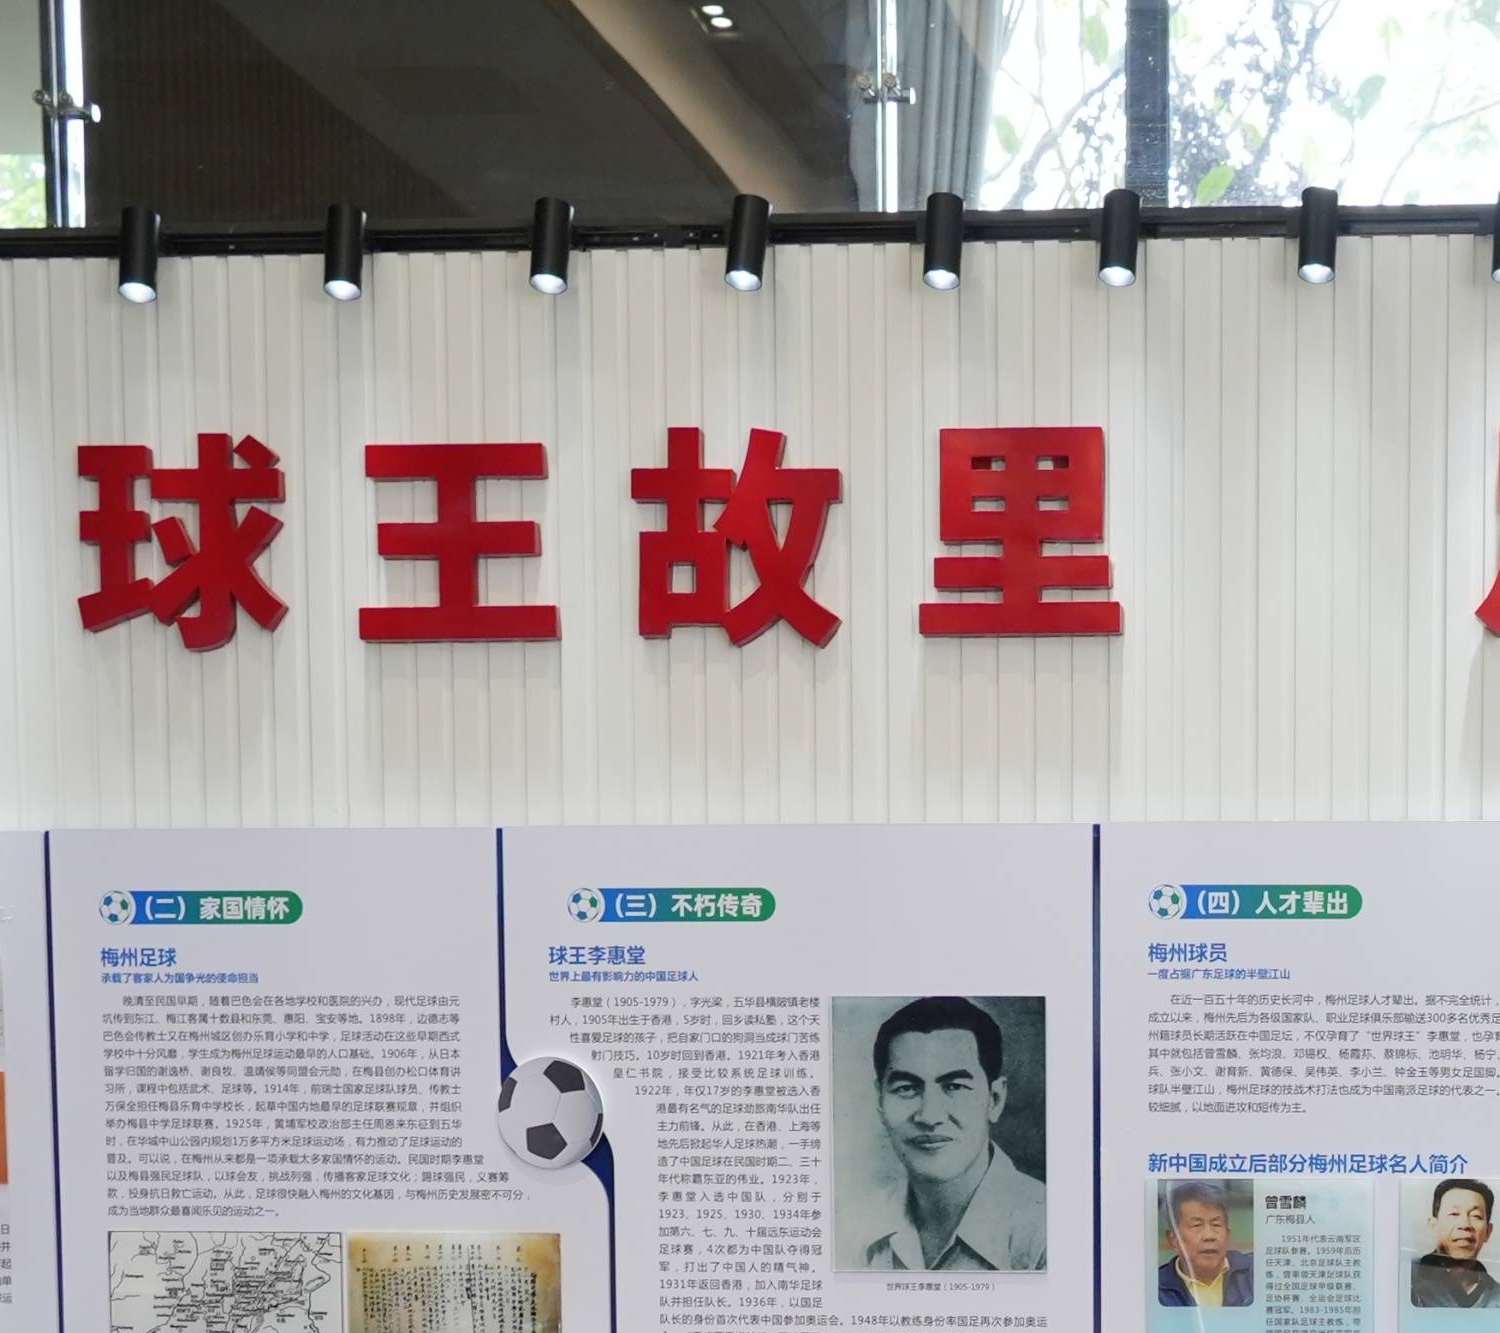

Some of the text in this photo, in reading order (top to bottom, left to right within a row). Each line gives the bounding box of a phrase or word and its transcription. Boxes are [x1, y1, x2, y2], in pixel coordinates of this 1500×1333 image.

[78, 425, 1123, 649] 球王故里
[100, 948, 177, 967] 梅州足球
[548, 945, 646, 965] 球王李惠堂
[1148, 943, 1228, 963] 梅州球员
[100, 973, 259, 984] 承载了客家人为国争光的使命担当
[548, 971, 699, 983] 世界上最有影响力的中国足球人
[1148, 968, 1291, 980] 一度占据广东足球的半壁江山
[1148, 1153, 1468, 1174] 新中国成立后部分梅州足球名人简介
[1265, 1195, 1307, 1210] 曾雪麟
